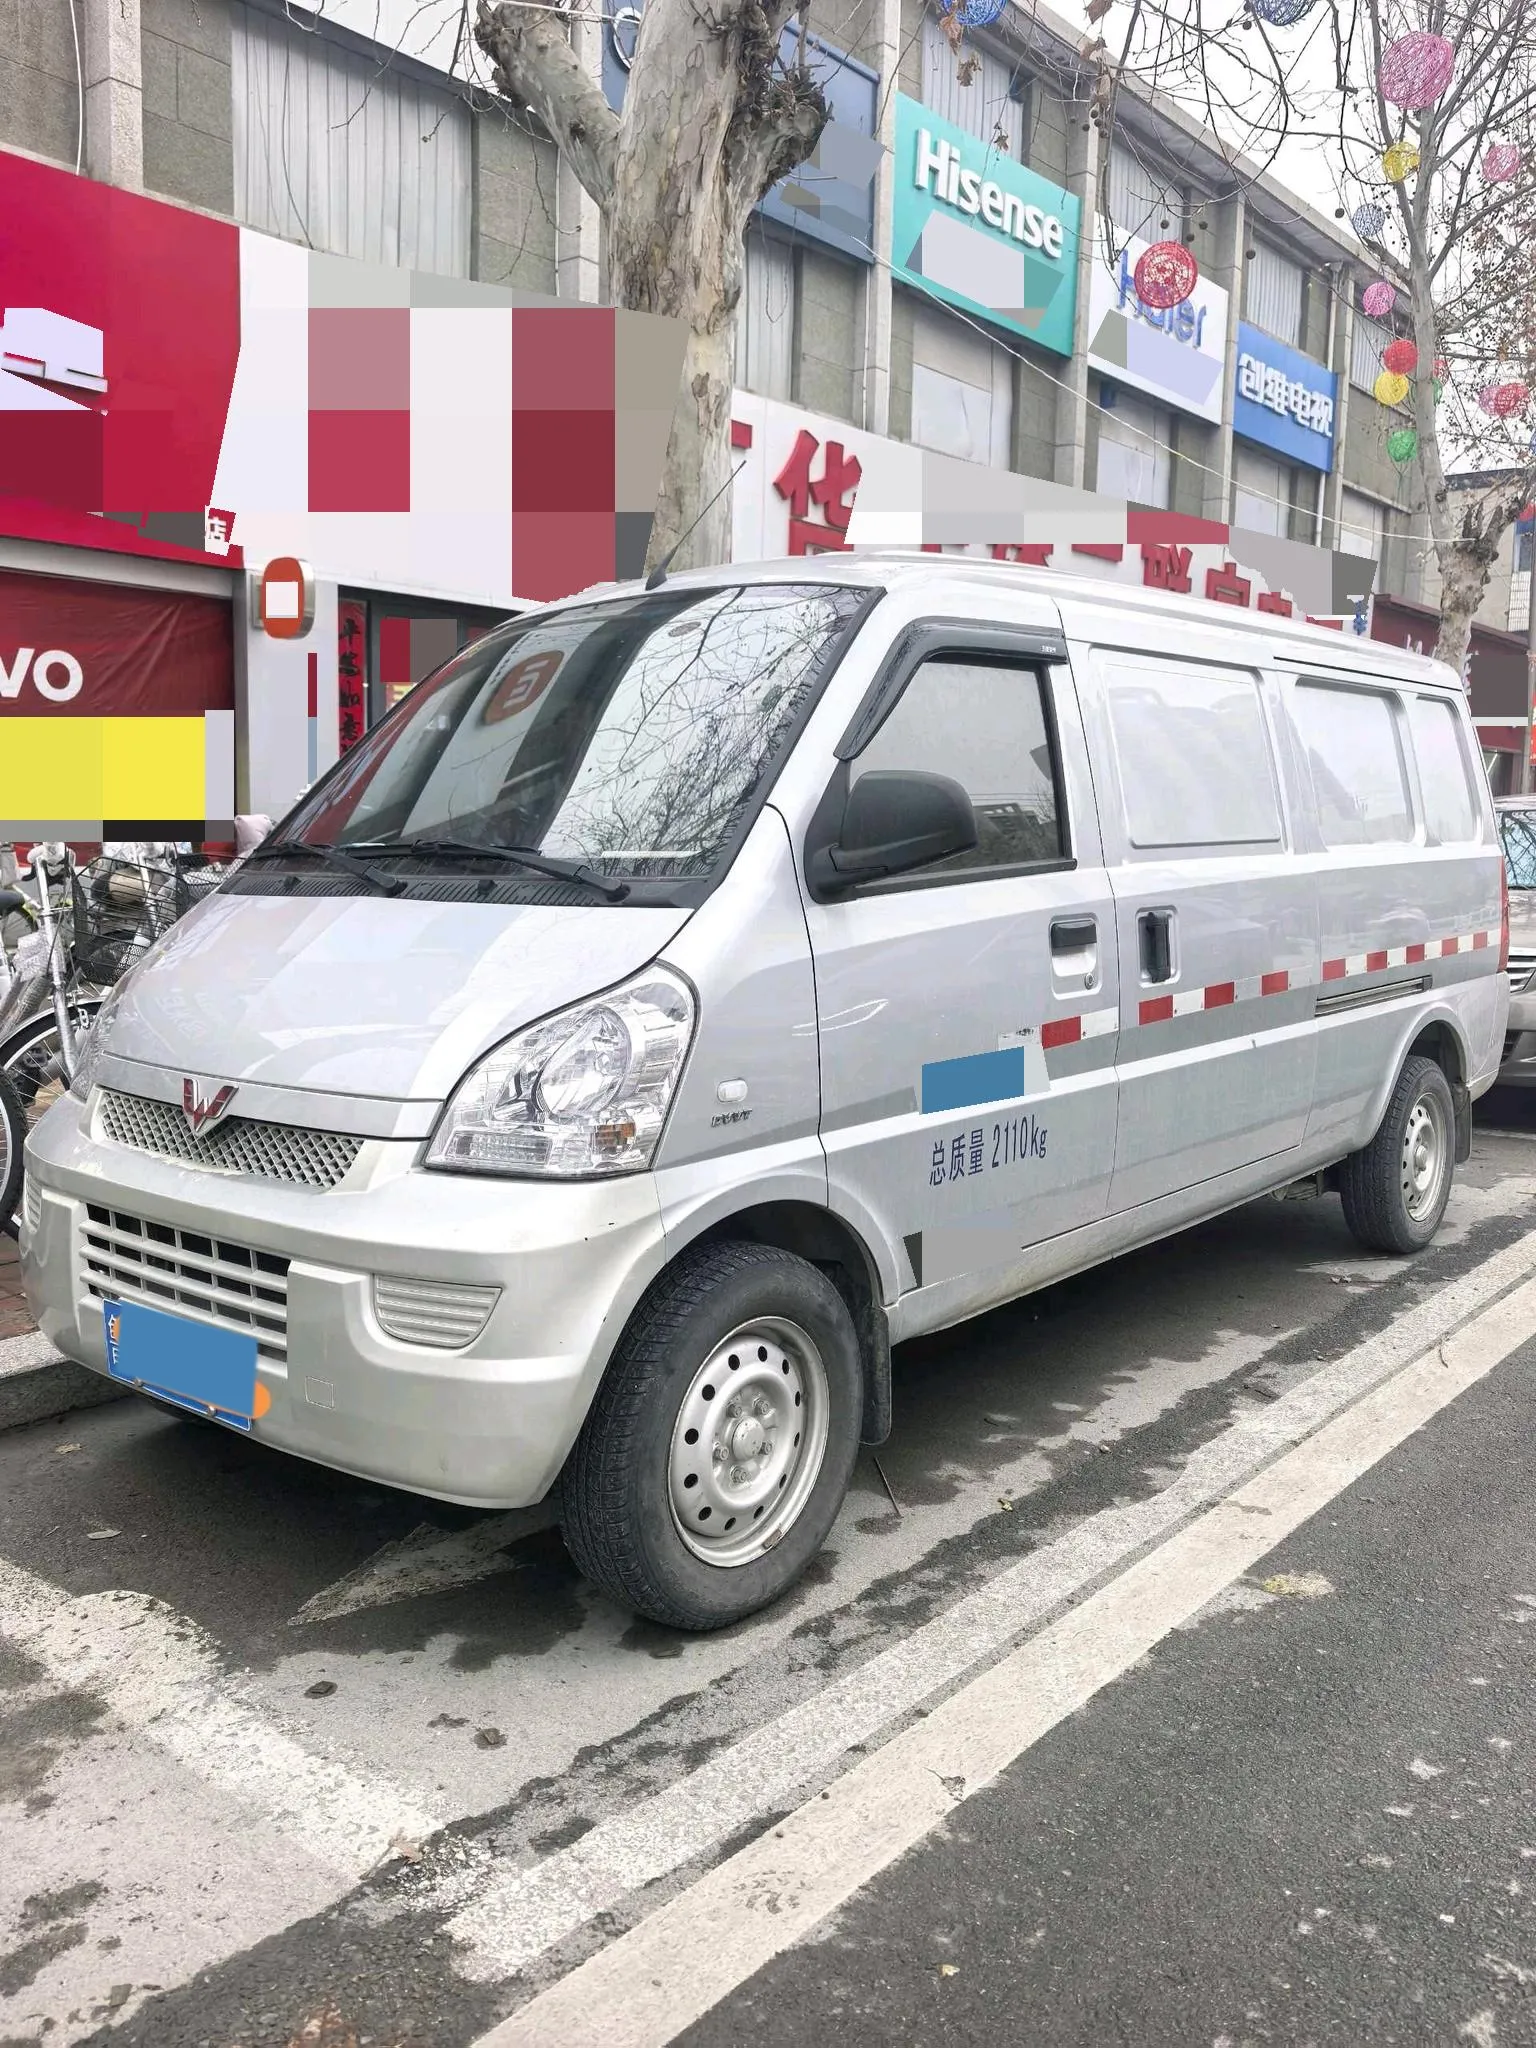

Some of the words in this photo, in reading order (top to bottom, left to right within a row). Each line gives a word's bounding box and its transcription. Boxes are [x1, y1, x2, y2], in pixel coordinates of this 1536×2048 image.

[915, 128, 1063, 259] Hisense
[1239, 352, 1333, 438] 创维电视
[929, 1128, 985, 1187] 总质量
[991, 1114, 1048, 1170] 2110kg
